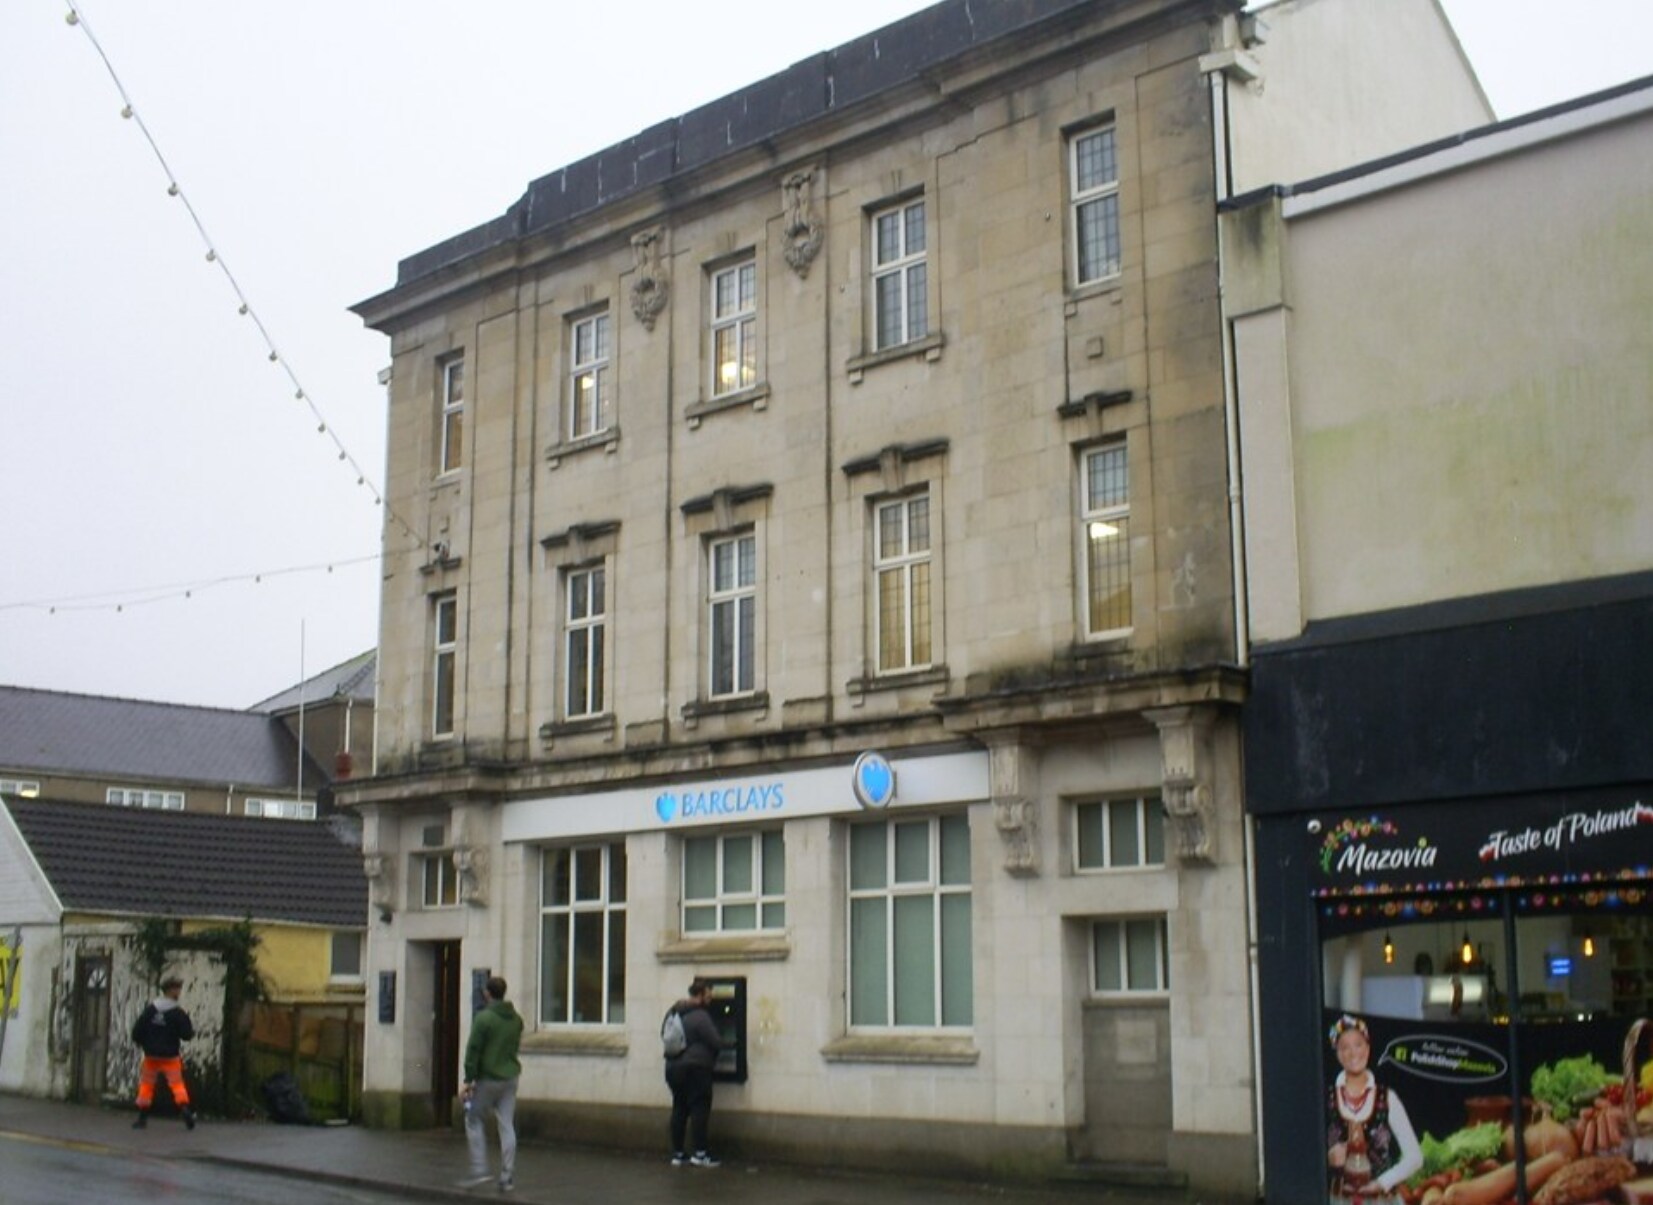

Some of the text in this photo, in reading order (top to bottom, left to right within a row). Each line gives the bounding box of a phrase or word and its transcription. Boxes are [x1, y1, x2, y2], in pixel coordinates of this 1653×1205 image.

[681, 783, 784, 817] BARCLAYS
[1489, 800, 1639, 861] Taste of Poland
[1336, 837, 1438, 877] Mazovia
